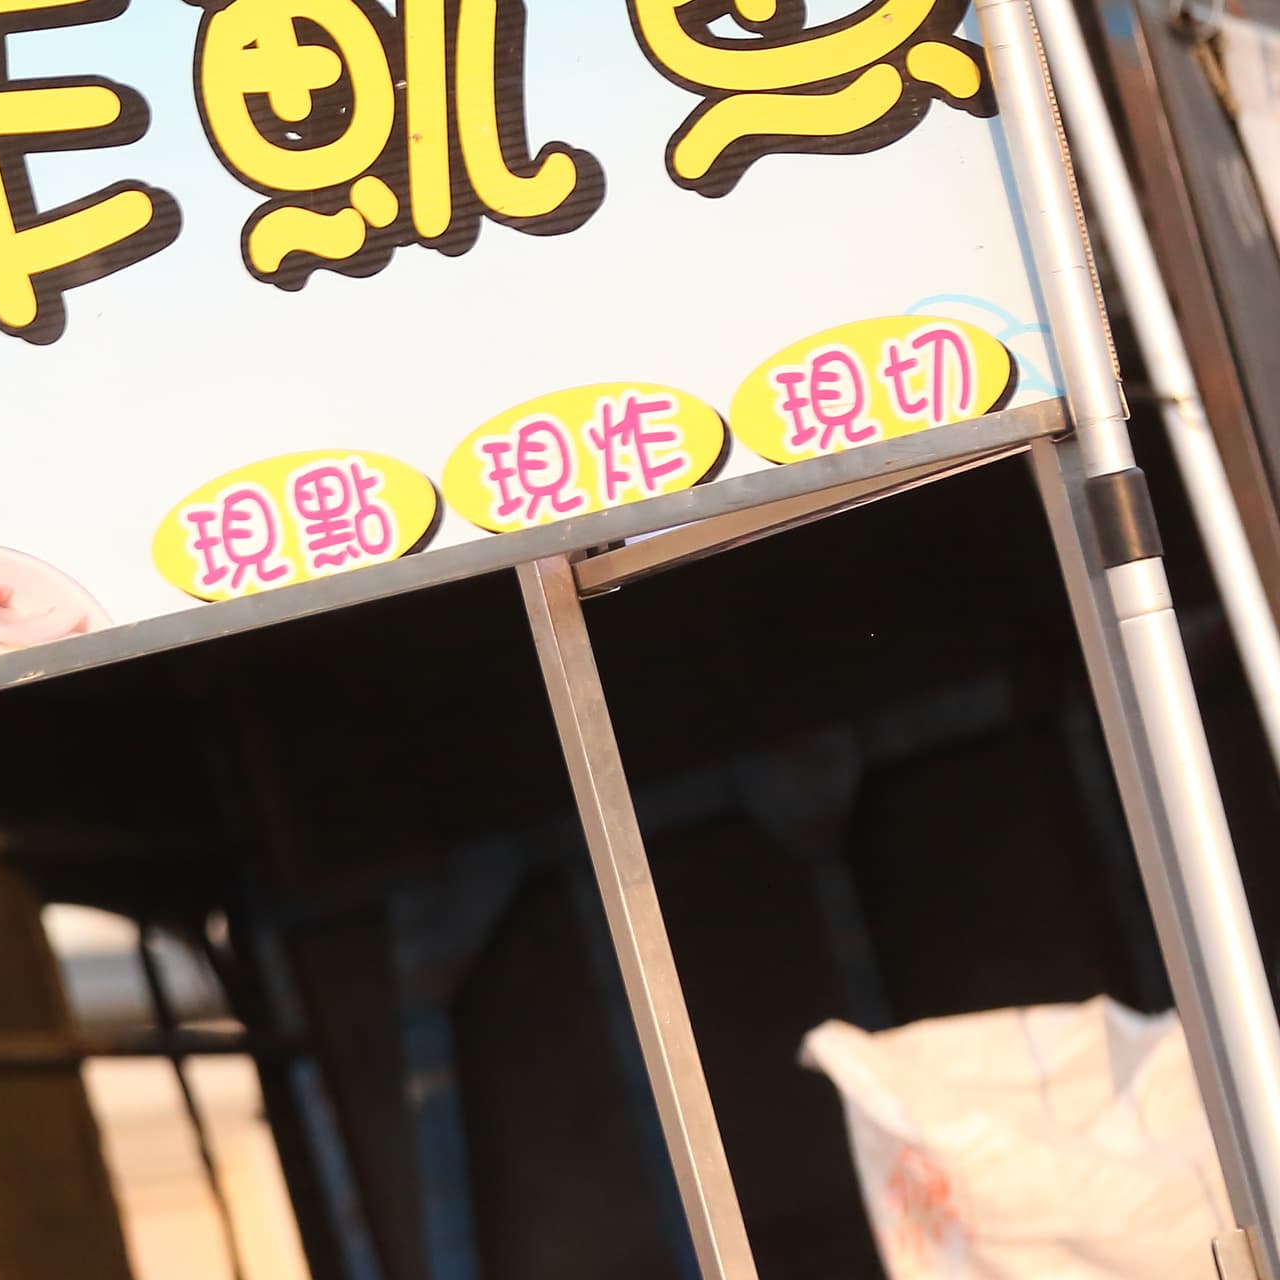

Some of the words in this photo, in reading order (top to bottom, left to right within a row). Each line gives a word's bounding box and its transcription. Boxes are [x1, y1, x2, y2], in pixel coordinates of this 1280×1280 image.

[187, 463, 392, 590] 現點
[482, 396, 685, 521] 現炸
[776, 328, 972, 450] 現切
